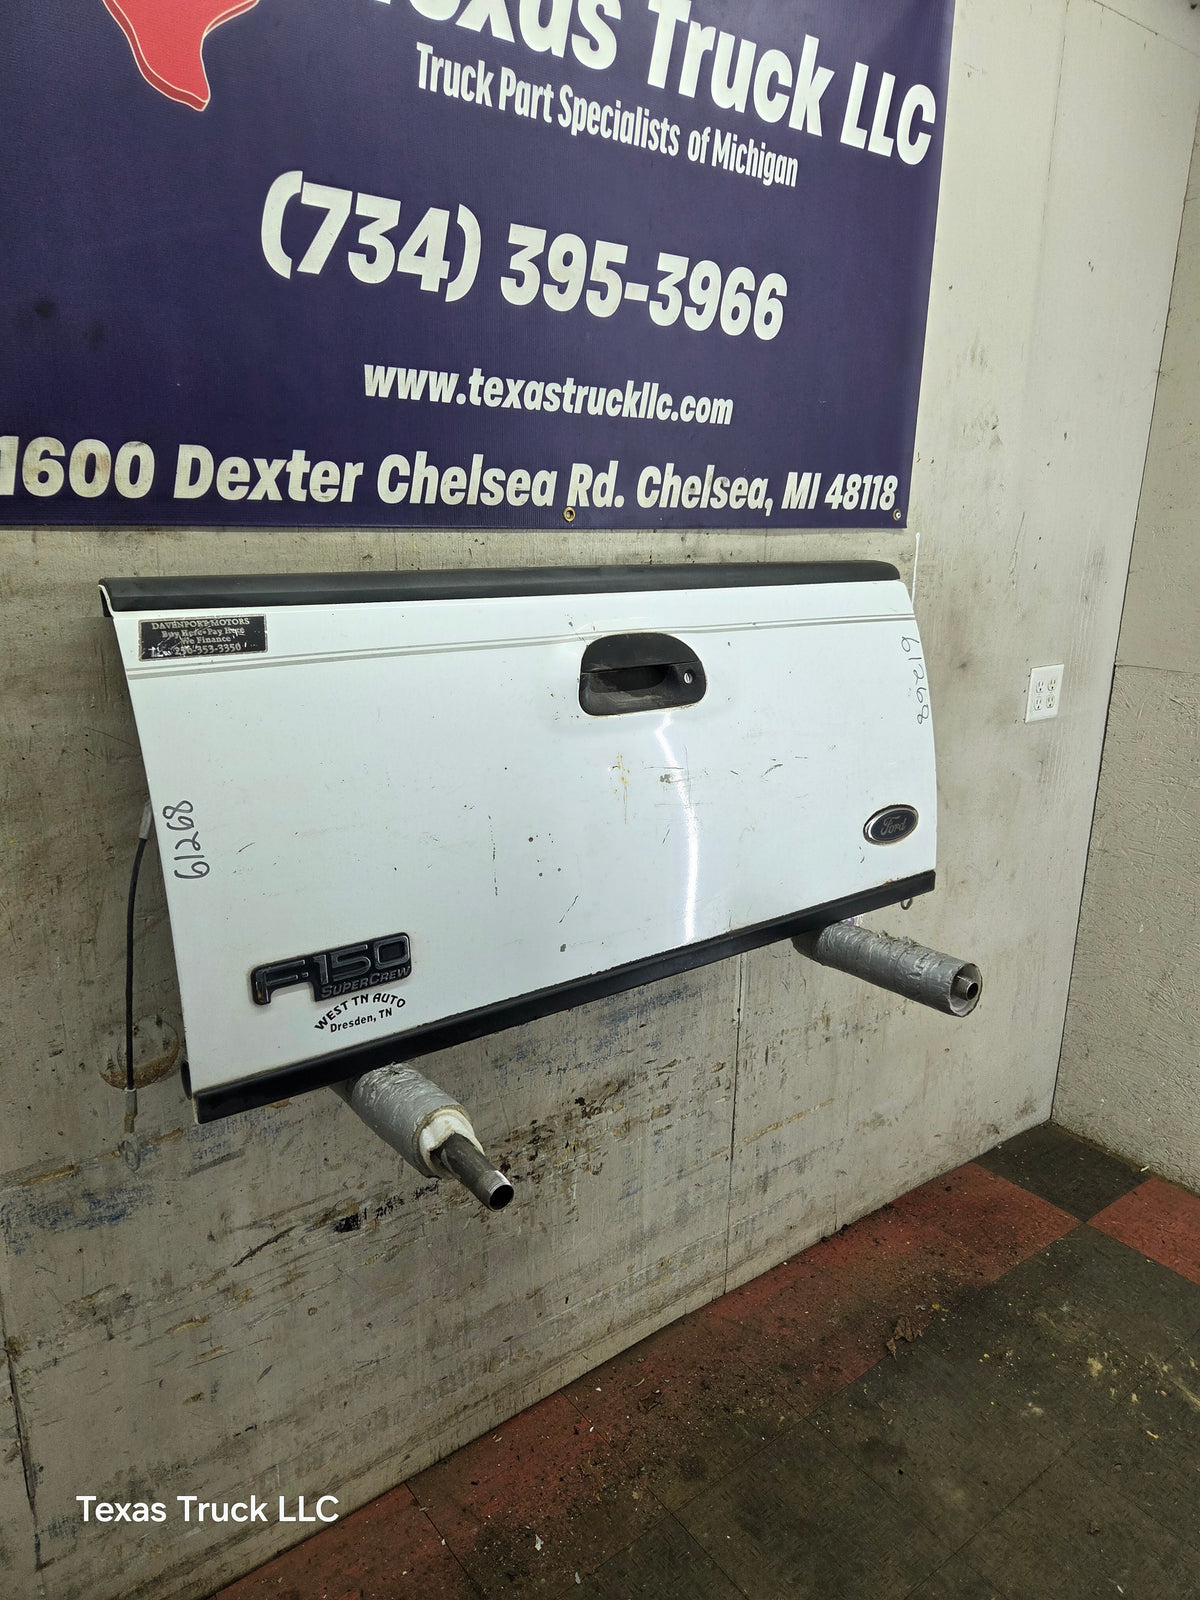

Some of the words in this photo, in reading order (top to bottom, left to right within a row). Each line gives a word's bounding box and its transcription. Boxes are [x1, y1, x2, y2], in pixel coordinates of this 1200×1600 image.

[416, 42, 492, 107] Truck
[499, 66, 553, 123] Part
[558, 85, 679, 156] Specialists
[687, 126, 710, 163] of
[712, 129, 798, 187] Michigan
[647, 0, 834, 137] Truck
[840, 62, 936, 165] LLC
[261, 170, 482, 302] (734)
[501, 224, 788, 340] 395-3966
[364, 364, 734, 425] www.texastruckllc.com
[0, 435, 155, 499] 1600
[173, 444, 364, 502] Dexter
[377, 451, 557, 507] Chelsea
[566, 460, 624, 508] Rd.
[637, 462, 773, 517] Chelsea,
[781, 472, 822, 510] MI
[824, 473, 898, 510] 48118
[196, 636, 232, 644] Finance
[901, 636, 929, 724] 61268
[162, 800, 210, 879] 61268
[880, 815, 907, 836] Ford
[314, 1000, 348, 1030] WEST
[351, 994, 369, 1006] TN
[372, 992, 406, 1008] AUTO
[330, 1014, 377, 1032] Dresden,
[379, 1007, 393, 1019] TN
